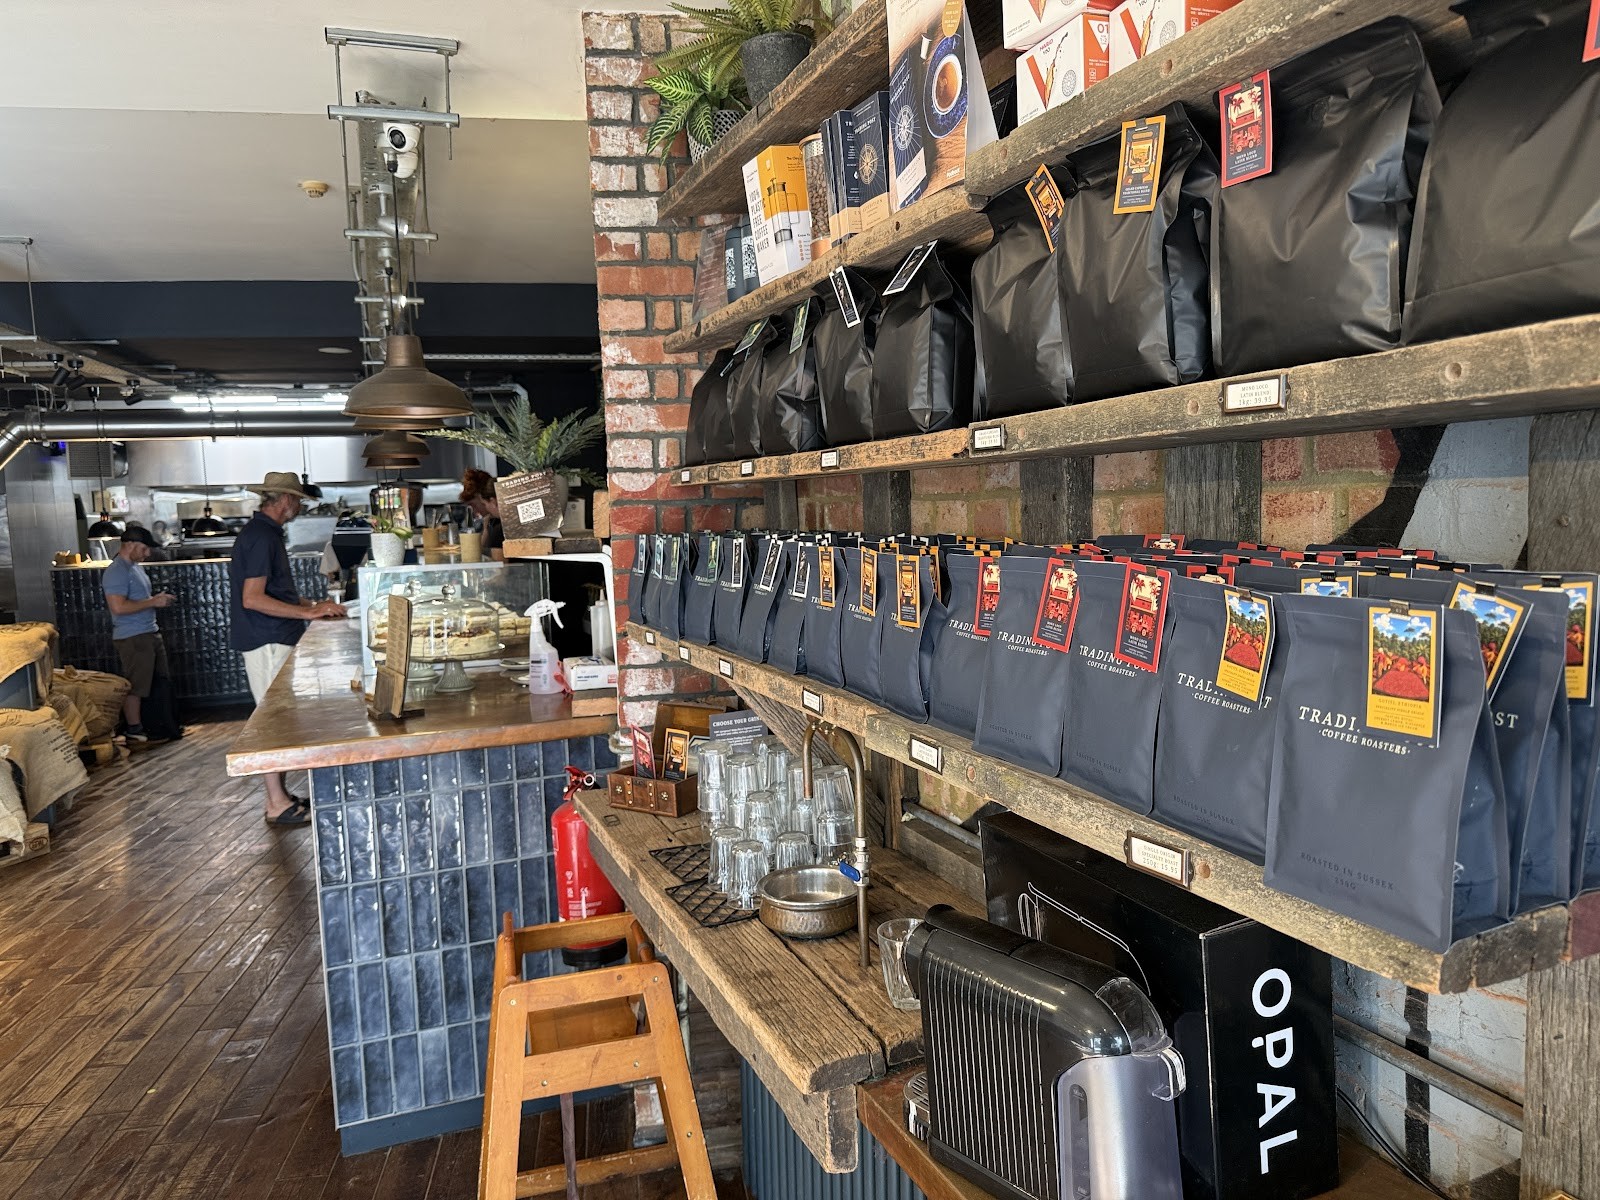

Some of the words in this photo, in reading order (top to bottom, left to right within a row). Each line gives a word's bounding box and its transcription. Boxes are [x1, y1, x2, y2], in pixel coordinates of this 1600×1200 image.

[754, 224, 768, 240] COFFEE
[502, 476, 530, 487] TRADING
[1007, 644, 1024, 652] COFFEE
[1025, 647, 1048, 656] ROASTERS
[1087, 660, 1107, 671] COFFEE
[1108, 665, 1136, 678] ROASTERS
[1194, 692, 1220, 706] COFFEE
[1221, 700, 1251, 714] ROASTERS
[1299, 705, 1360, 733] TRADI
[1321, 727, 1358, 744] COFFEE
[1360, 737, 1407, 755] ROASTERS
[1300, 852, 1339, 872] ROASTED
[1342, 867, 1353, 877] IN
[1357, 872, 1394, 890] SUSSEX
[1252, 968, 1298, 1174] OPAL
